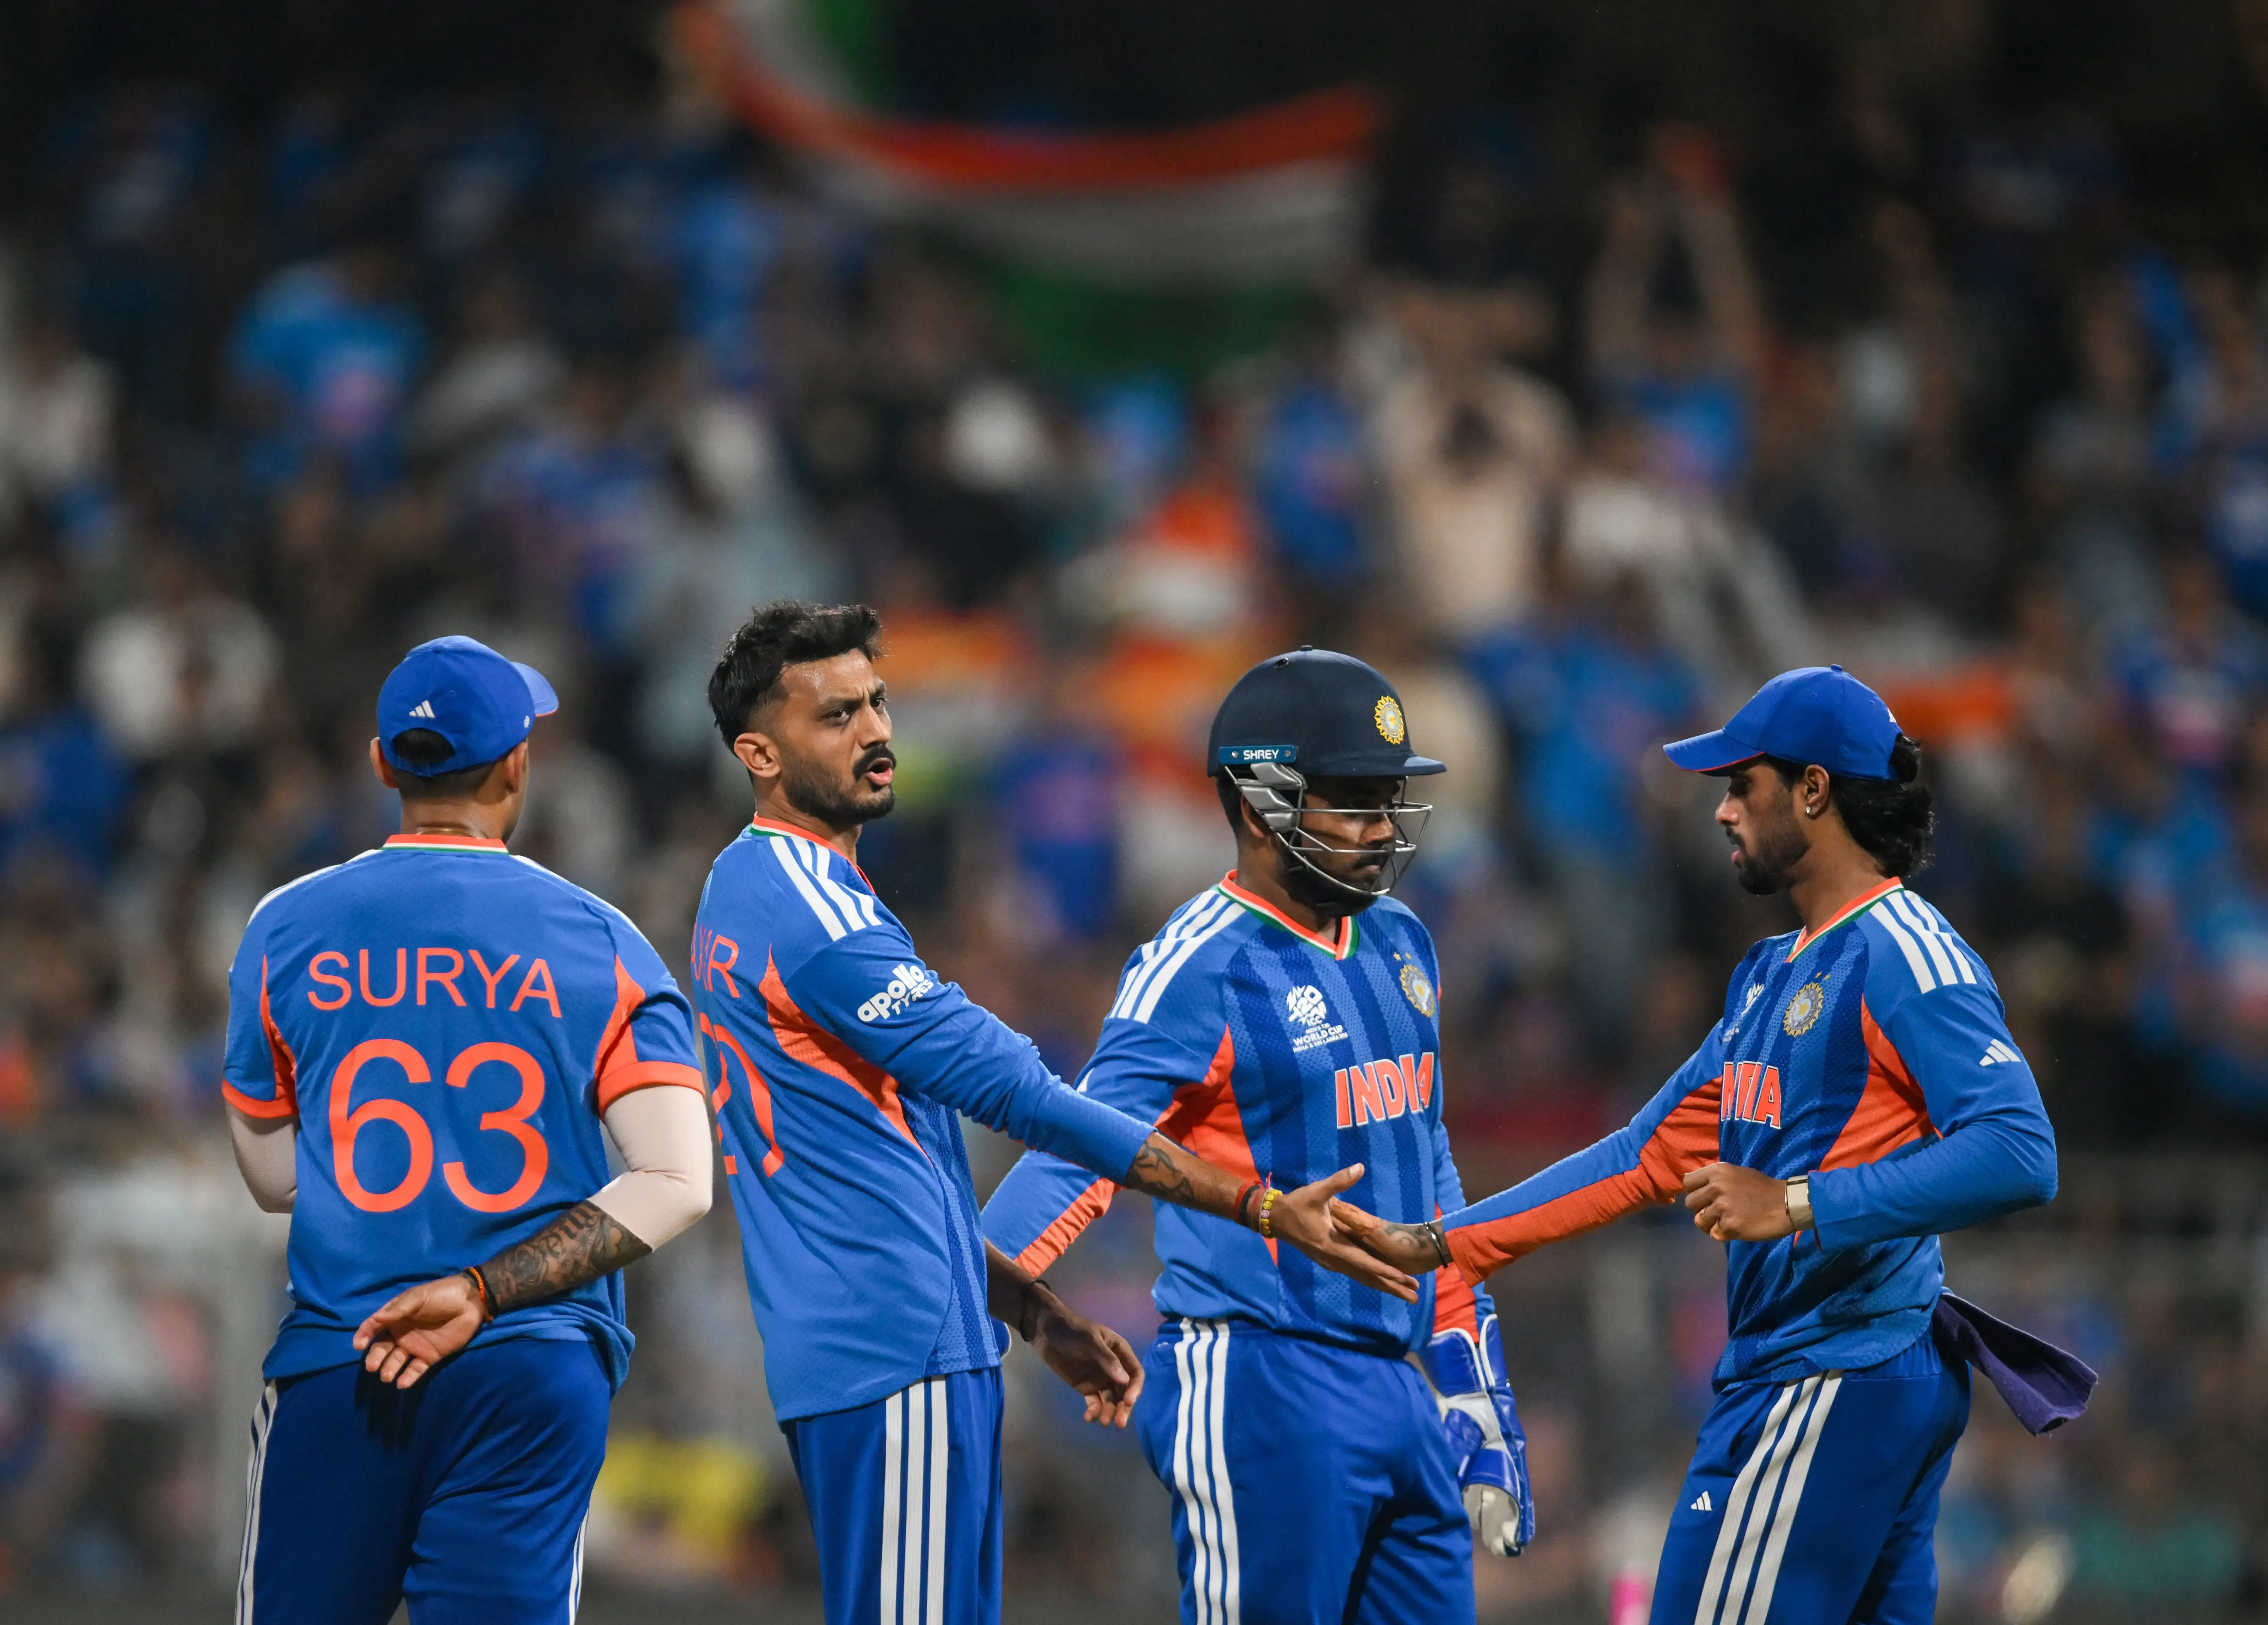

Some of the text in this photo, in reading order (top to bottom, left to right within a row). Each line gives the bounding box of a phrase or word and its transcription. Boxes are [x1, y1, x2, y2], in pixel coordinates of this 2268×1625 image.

[1243, 749, 1279, 760] SHREY
[308, 948, 561, 1017] SURYA
[857, 963, 924, 1022] apollo
[891, 979, 933, 1015] TYRES
[1293, 1030, 1328, 1045] WORLD
[1328, 1025, 1343, 1035] CUP
[1307, 1016, 1322, 1027] ICC
[1335, 1052, 1434, 1129] INDIA
[329, 1038, 548, 1212] 63
